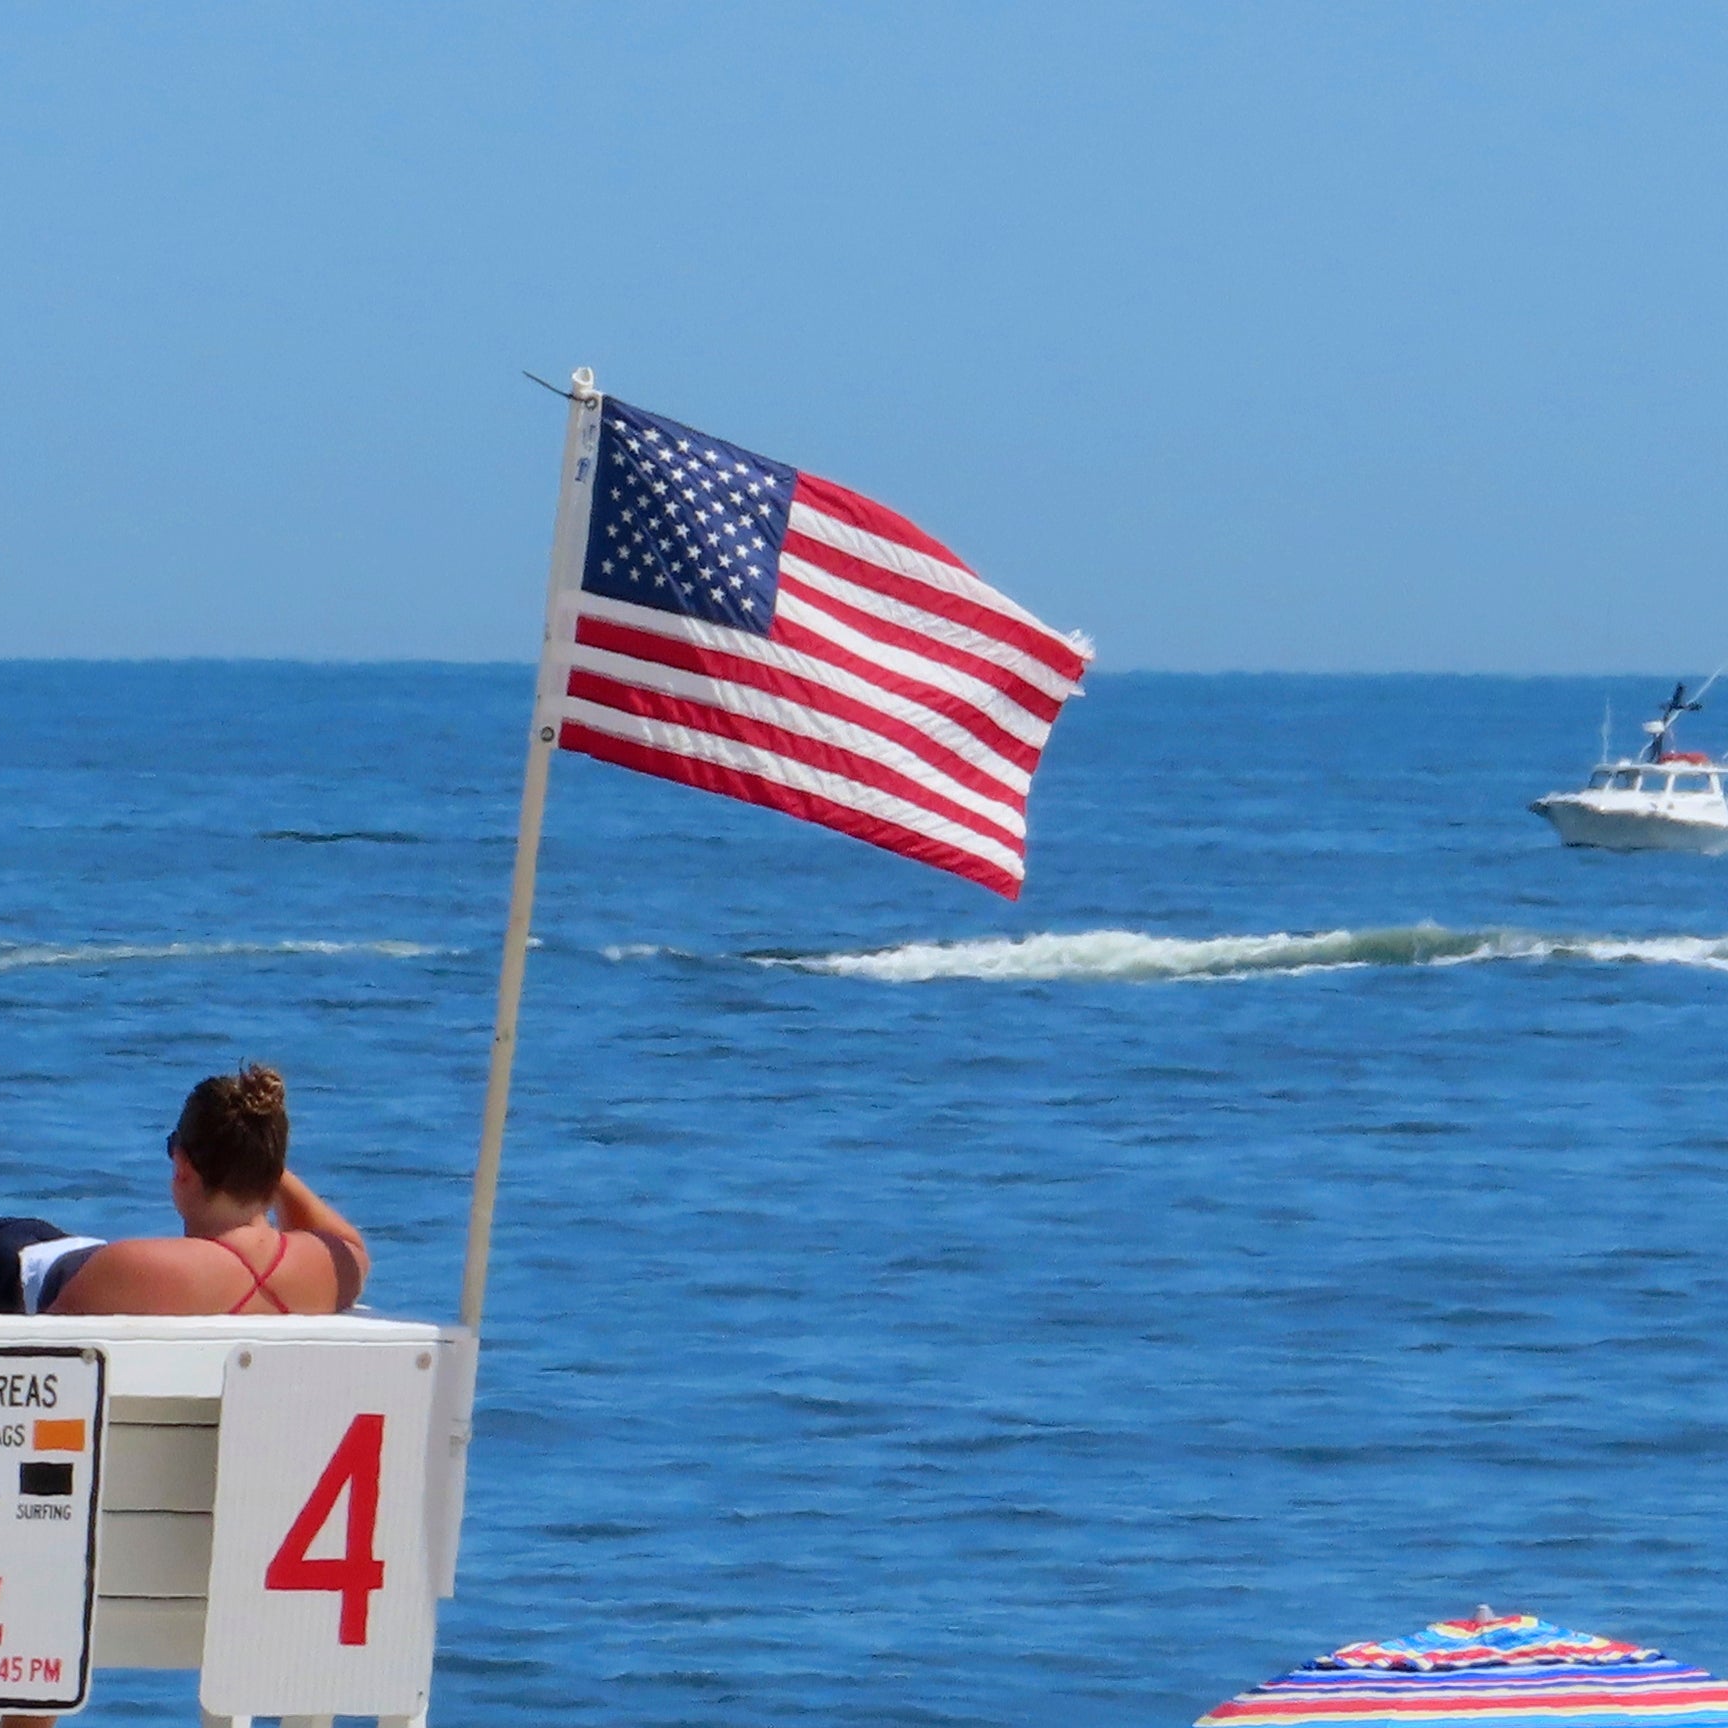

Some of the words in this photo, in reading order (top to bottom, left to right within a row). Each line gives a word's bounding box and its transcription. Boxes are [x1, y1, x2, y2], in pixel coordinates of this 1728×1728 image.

[16, 1503, 72, 1521] SURFING
[264, 1413, 386, 1647] 4
[28, 1656, 62, 1683] PM
